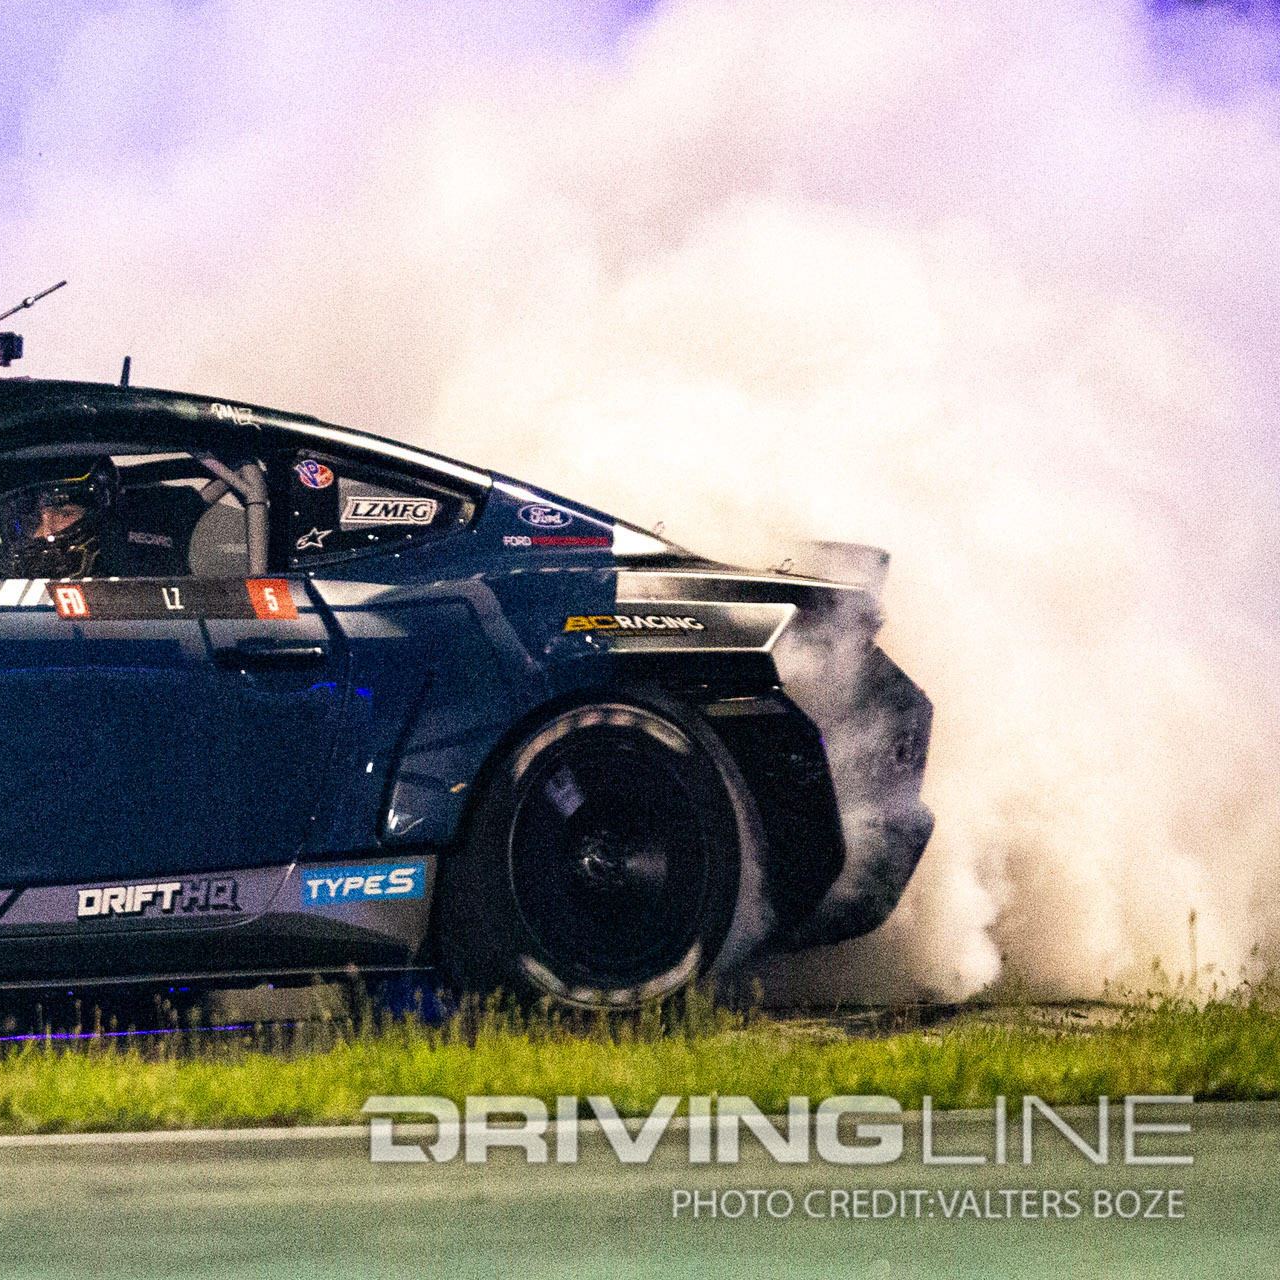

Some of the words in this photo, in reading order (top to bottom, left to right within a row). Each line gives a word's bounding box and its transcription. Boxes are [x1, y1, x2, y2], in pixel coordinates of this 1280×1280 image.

[351, 503, 428, 518] LZMFG
[529, 504, 564, 524] Ford
[56, 588, 86, 615] FD
[264, 587, 278, 612] 5
